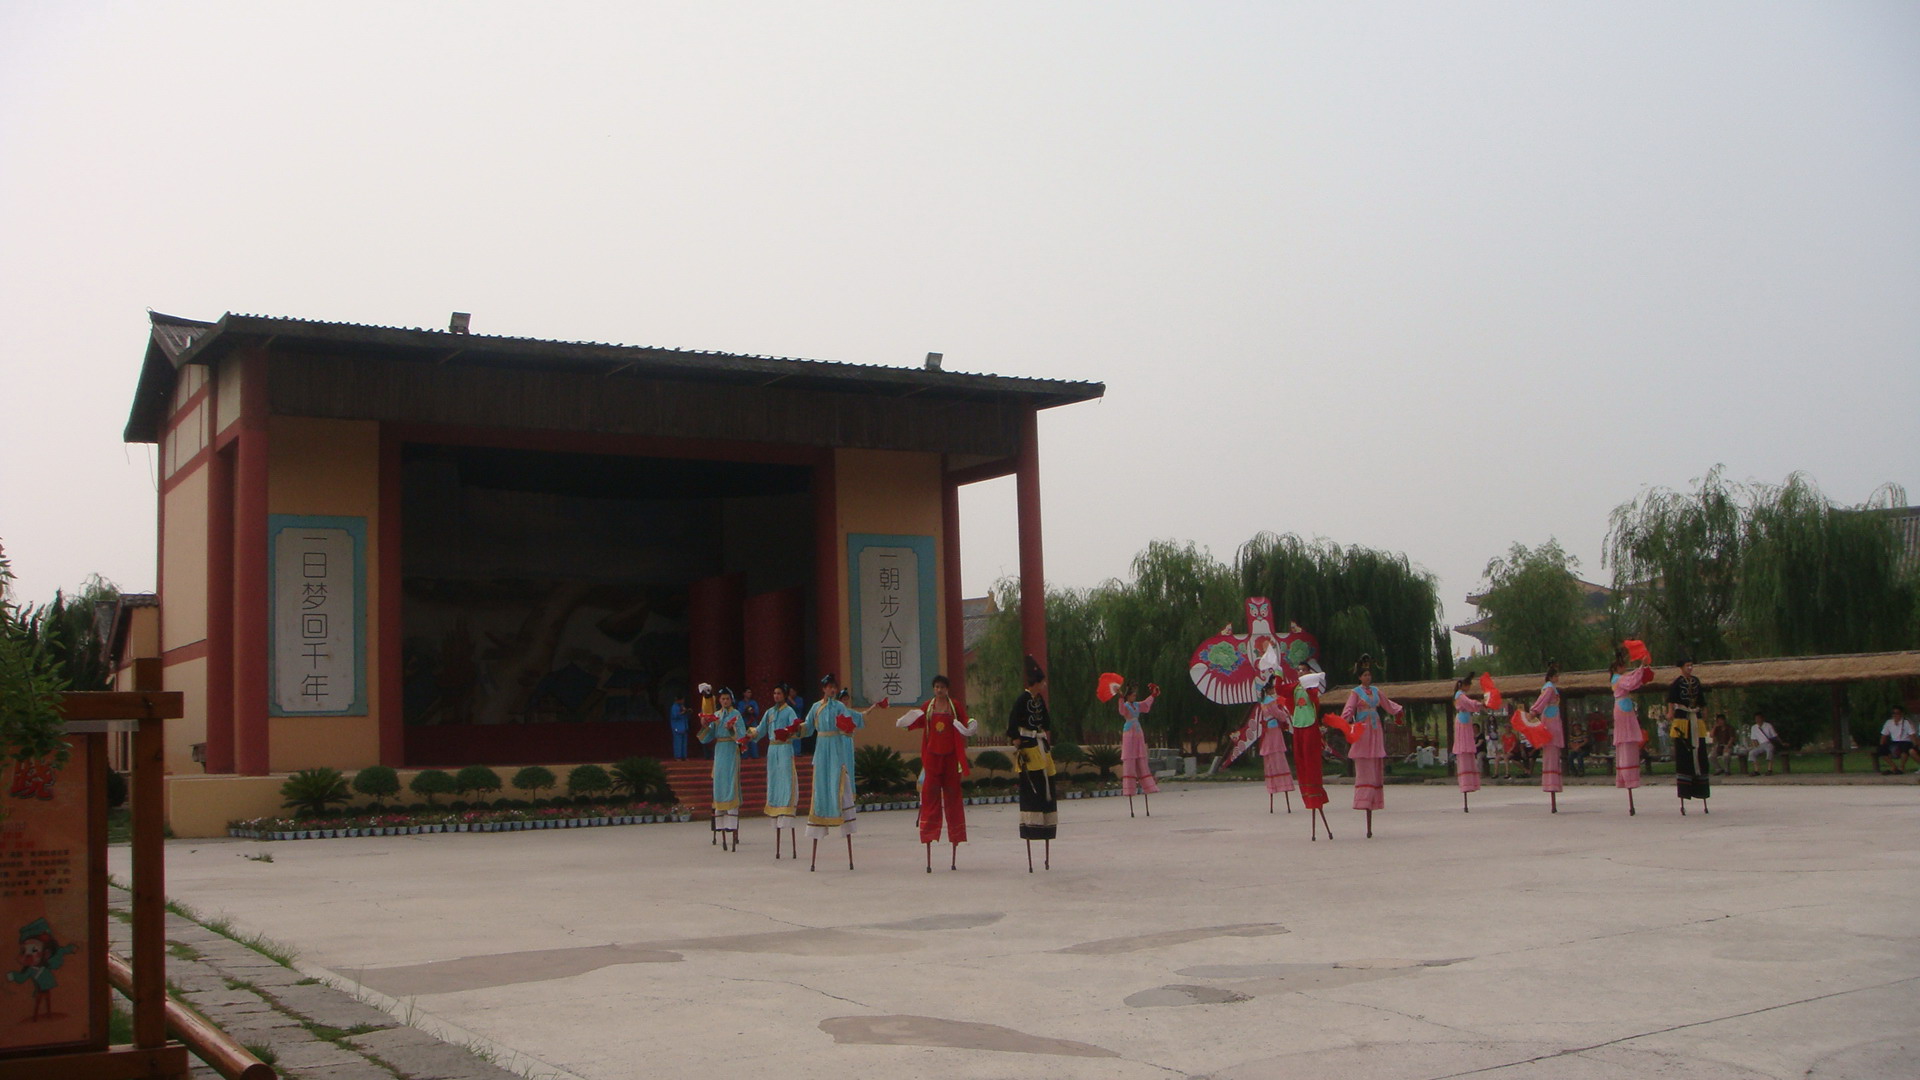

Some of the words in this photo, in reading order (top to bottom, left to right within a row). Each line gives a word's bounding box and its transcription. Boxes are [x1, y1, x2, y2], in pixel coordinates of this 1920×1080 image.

[301, 536, 329, 702] 一日梦回千年
[879, 554, 903, 696] 一朝步入画卷
